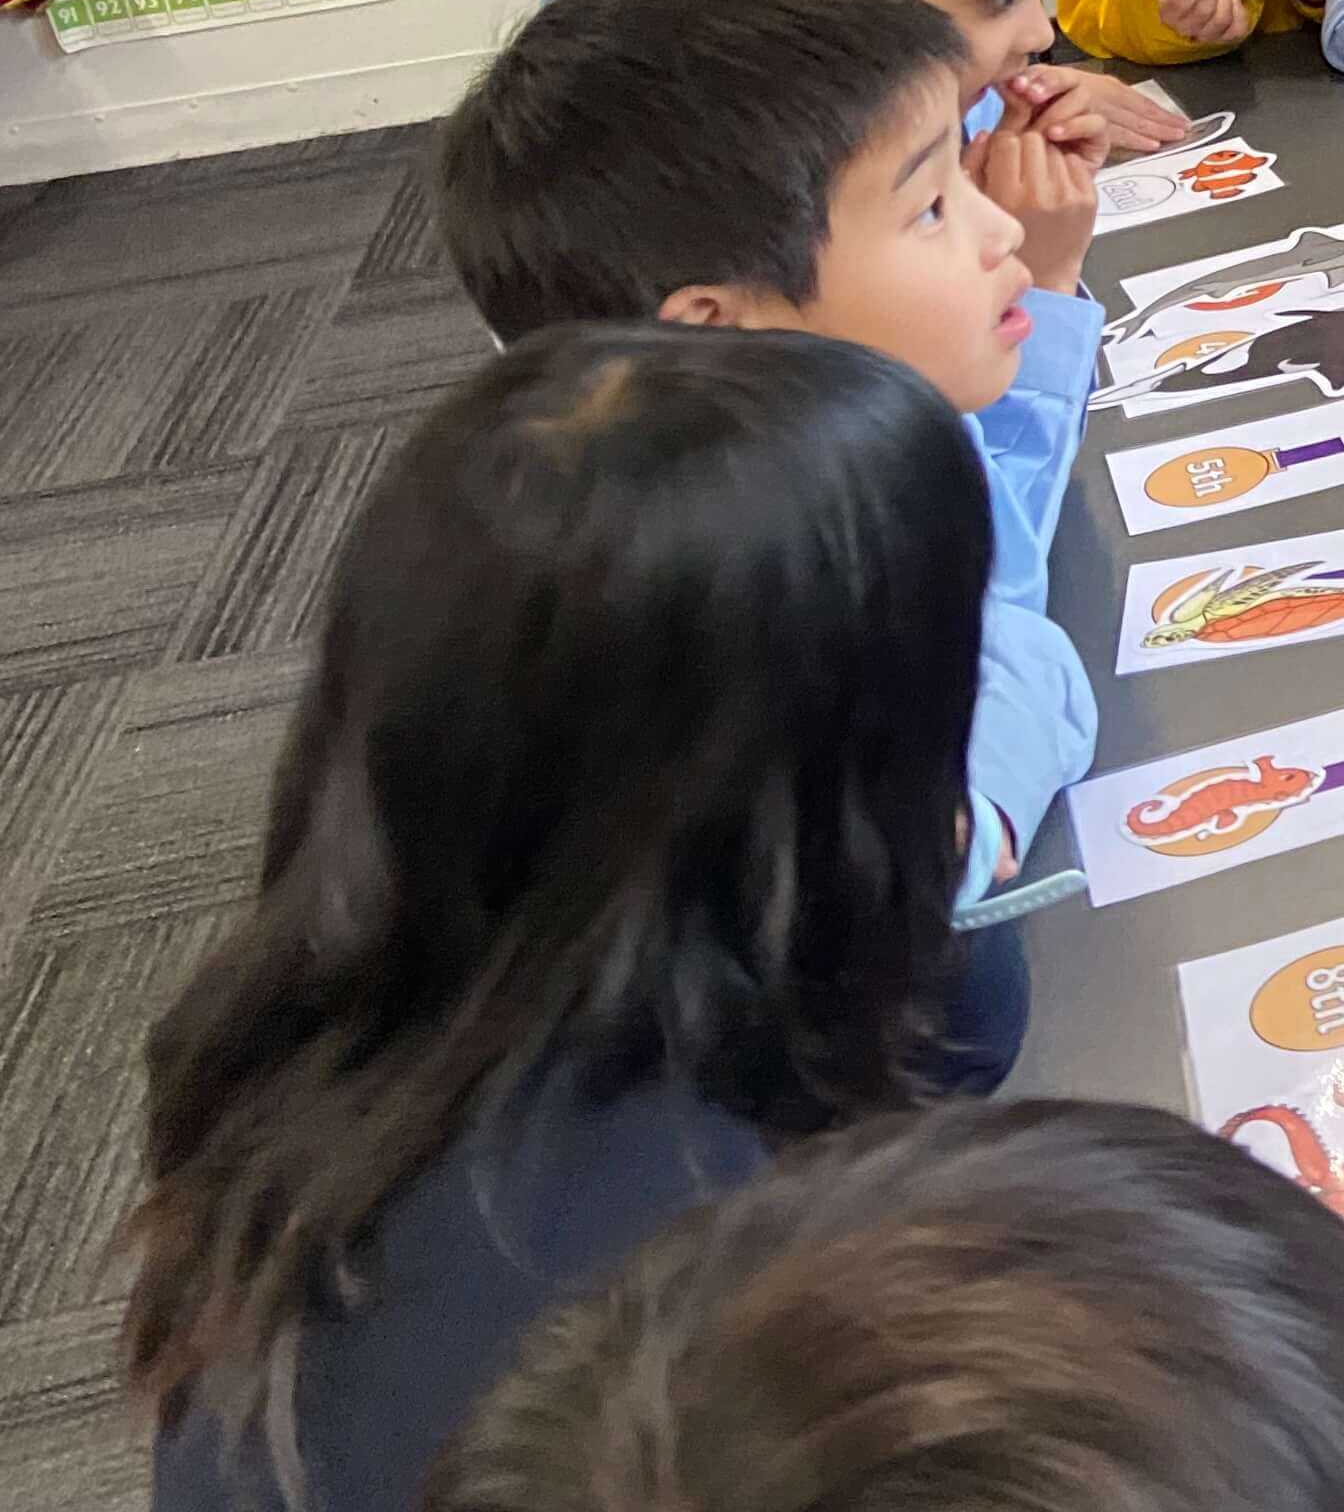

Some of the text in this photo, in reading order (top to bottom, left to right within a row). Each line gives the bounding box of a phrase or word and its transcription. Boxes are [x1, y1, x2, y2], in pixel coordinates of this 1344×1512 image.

[57, 6, 79, 25] 91
[95, 0, 122, 16] 92
[1185, 457, 1233, 498] 5th
